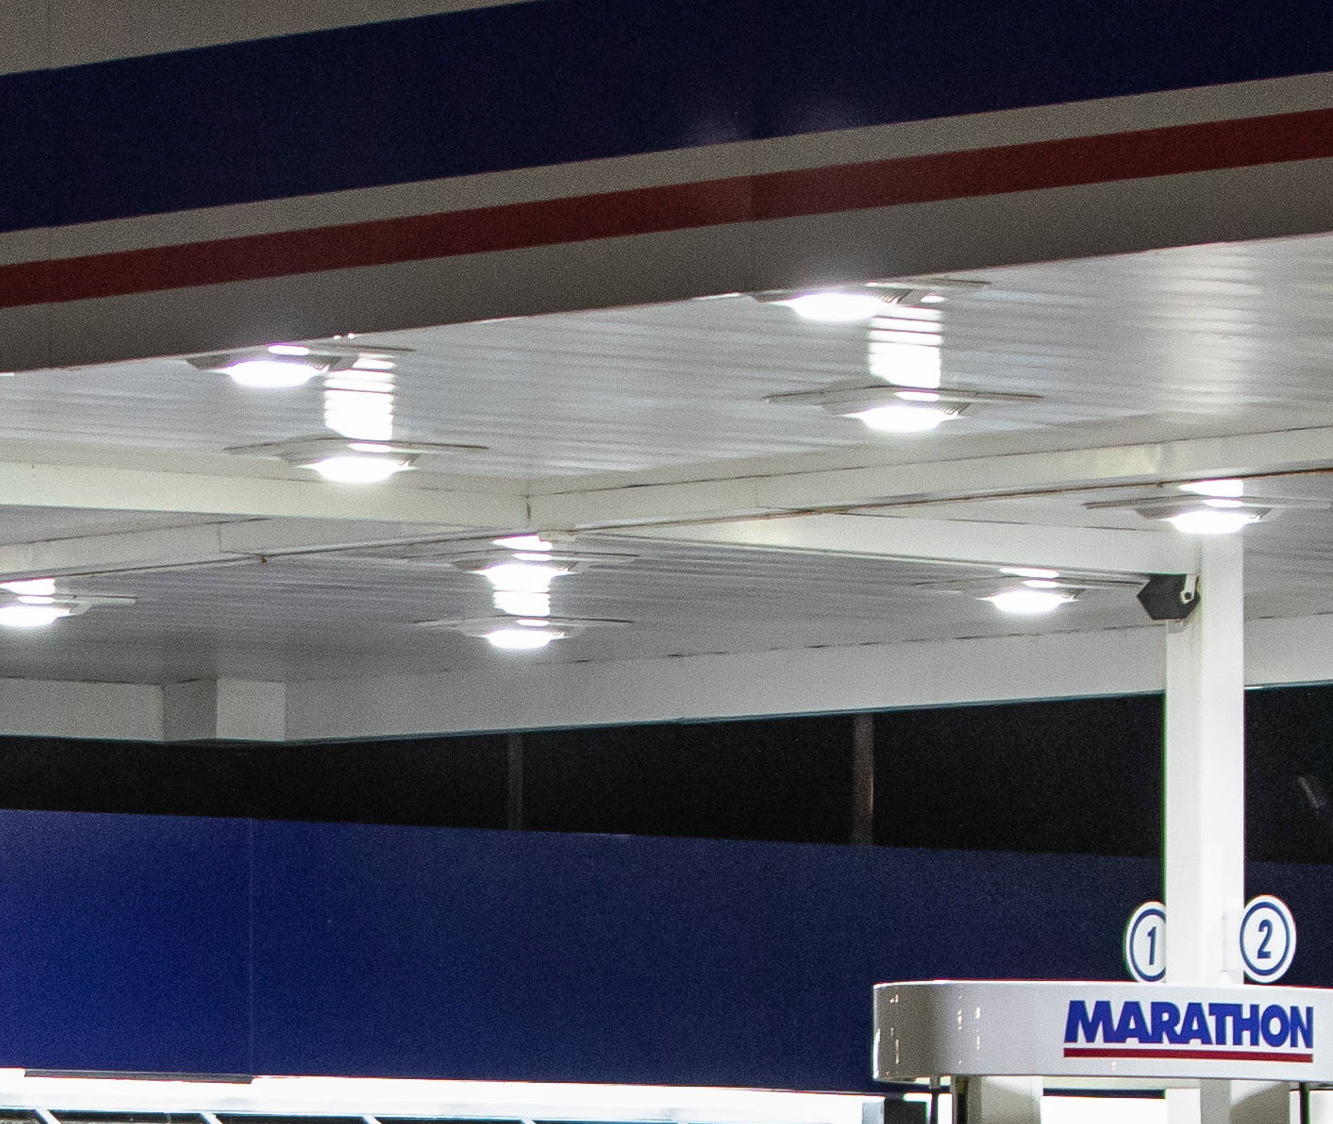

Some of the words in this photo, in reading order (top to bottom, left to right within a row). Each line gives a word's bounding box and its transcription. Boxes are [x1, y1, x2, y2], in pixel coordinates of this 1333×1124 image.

[1147, 926, 1157, 965] 1
[1257, 918, 1274, 959] 2
[1064, 1000, 1314, 1048] MARATHON
